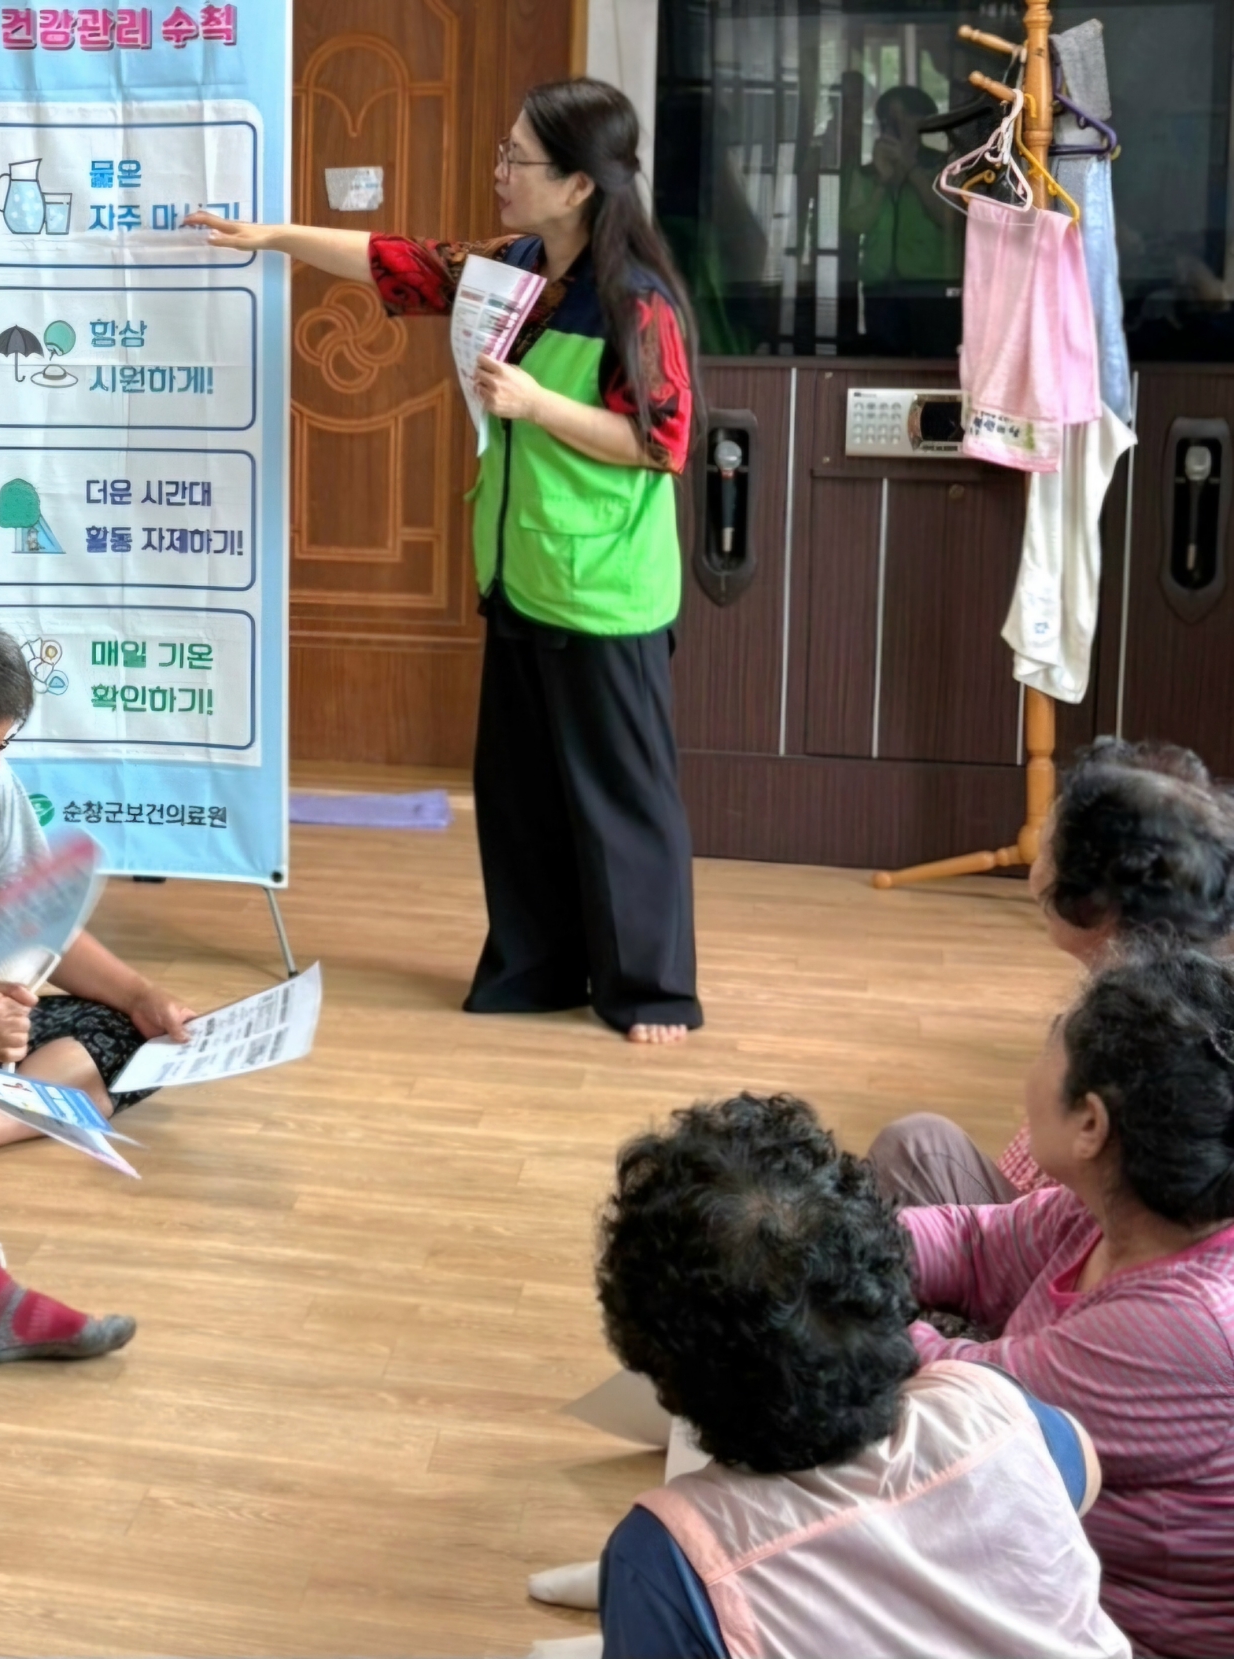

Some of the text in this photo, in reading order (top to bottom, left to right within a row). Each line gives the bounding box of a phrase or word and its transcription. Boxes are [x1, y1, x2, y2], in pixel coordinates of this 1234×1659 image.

[89, 204, 142, 231] 자주
[89, 319, 147, 347] 항상
[89, 365, 214, 394] 시원하게!
[86, 479, 212, 506] 더운 시간대
[85, 525, 243, 556] 활동 자제하기!
[91, 640, 214, 670] 매일 기온
[91, 684, 214, 715] 확인하기!
[62, 800, 228, 829] 순창군보건의료원
